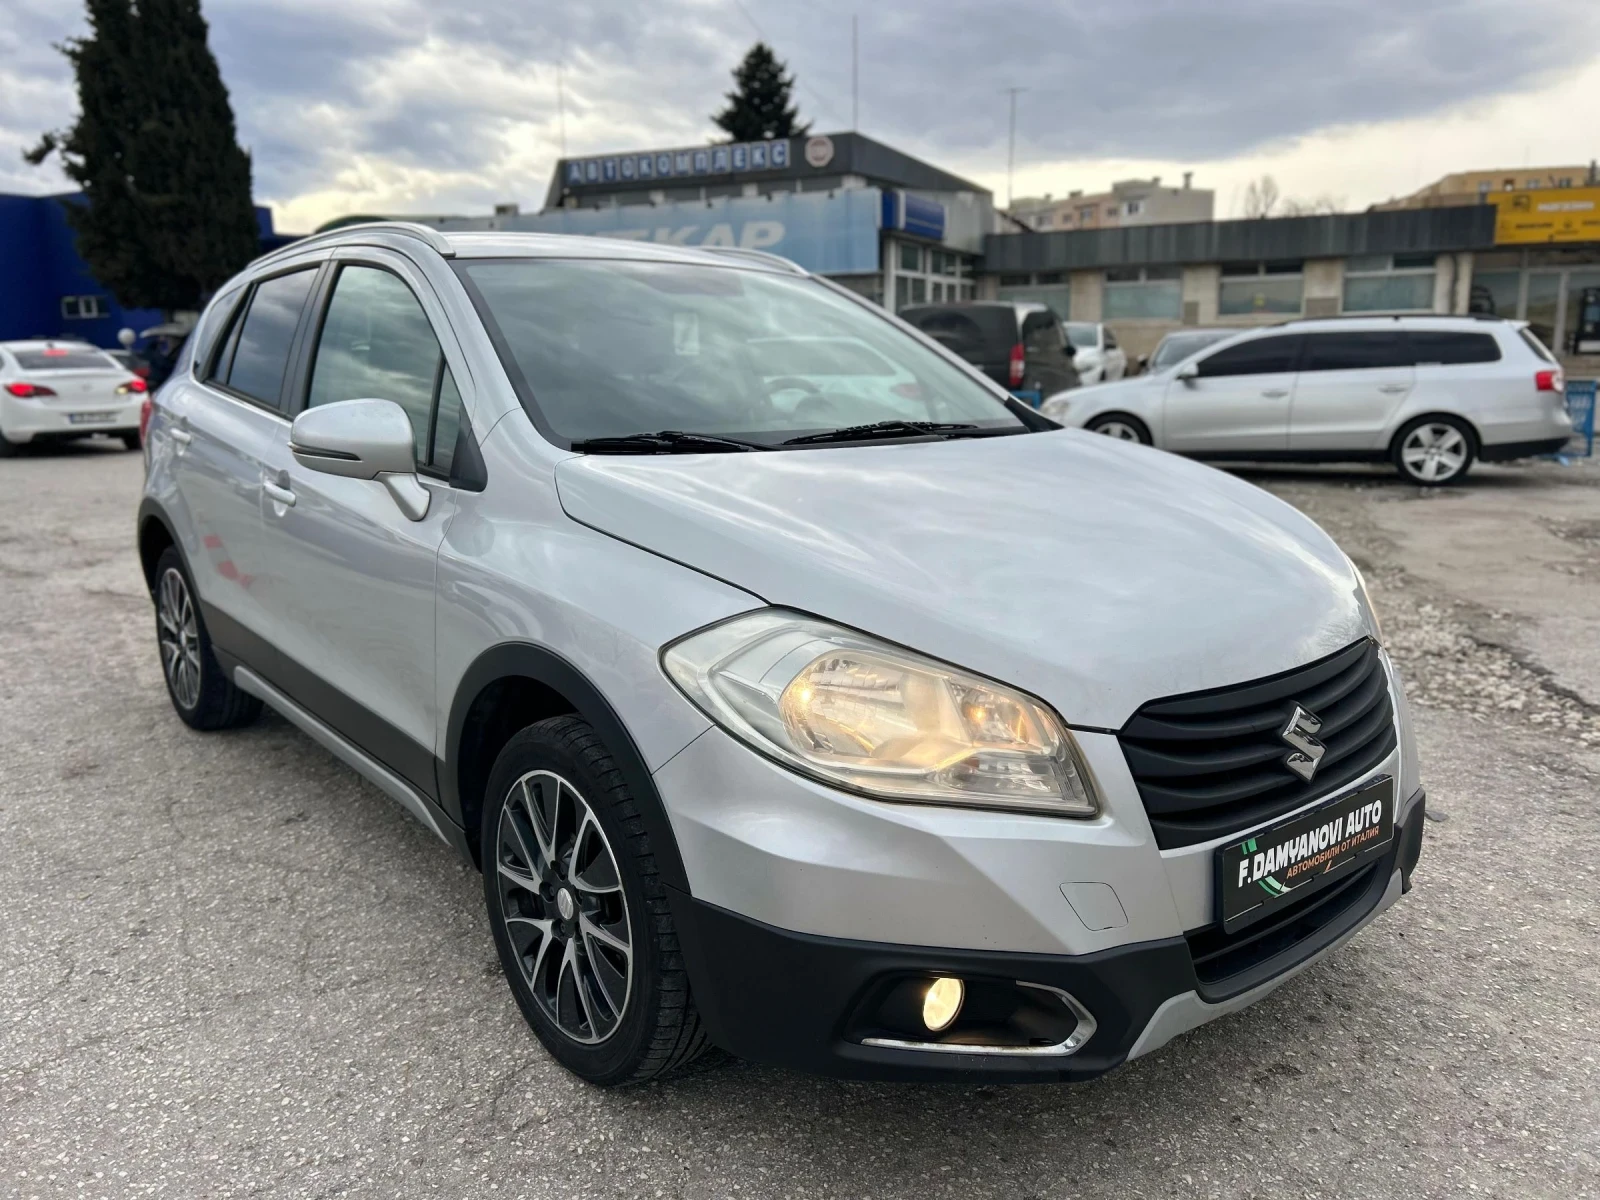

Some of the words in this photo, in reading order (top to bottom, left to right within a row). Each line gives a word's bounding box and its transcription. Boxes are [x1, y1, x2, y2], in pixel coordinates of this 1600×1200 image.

[568, 144, 787, 182] АВТОКОМПЛЕКС
[1345, 799, 1382, 838] AUTO
[1286, 845, 1340, 879] АВТОМОБИЛИ
[1341, 839, 1351, 852] ОТ
[1351, 825, 1380, 847] ИТАЛИЯ
